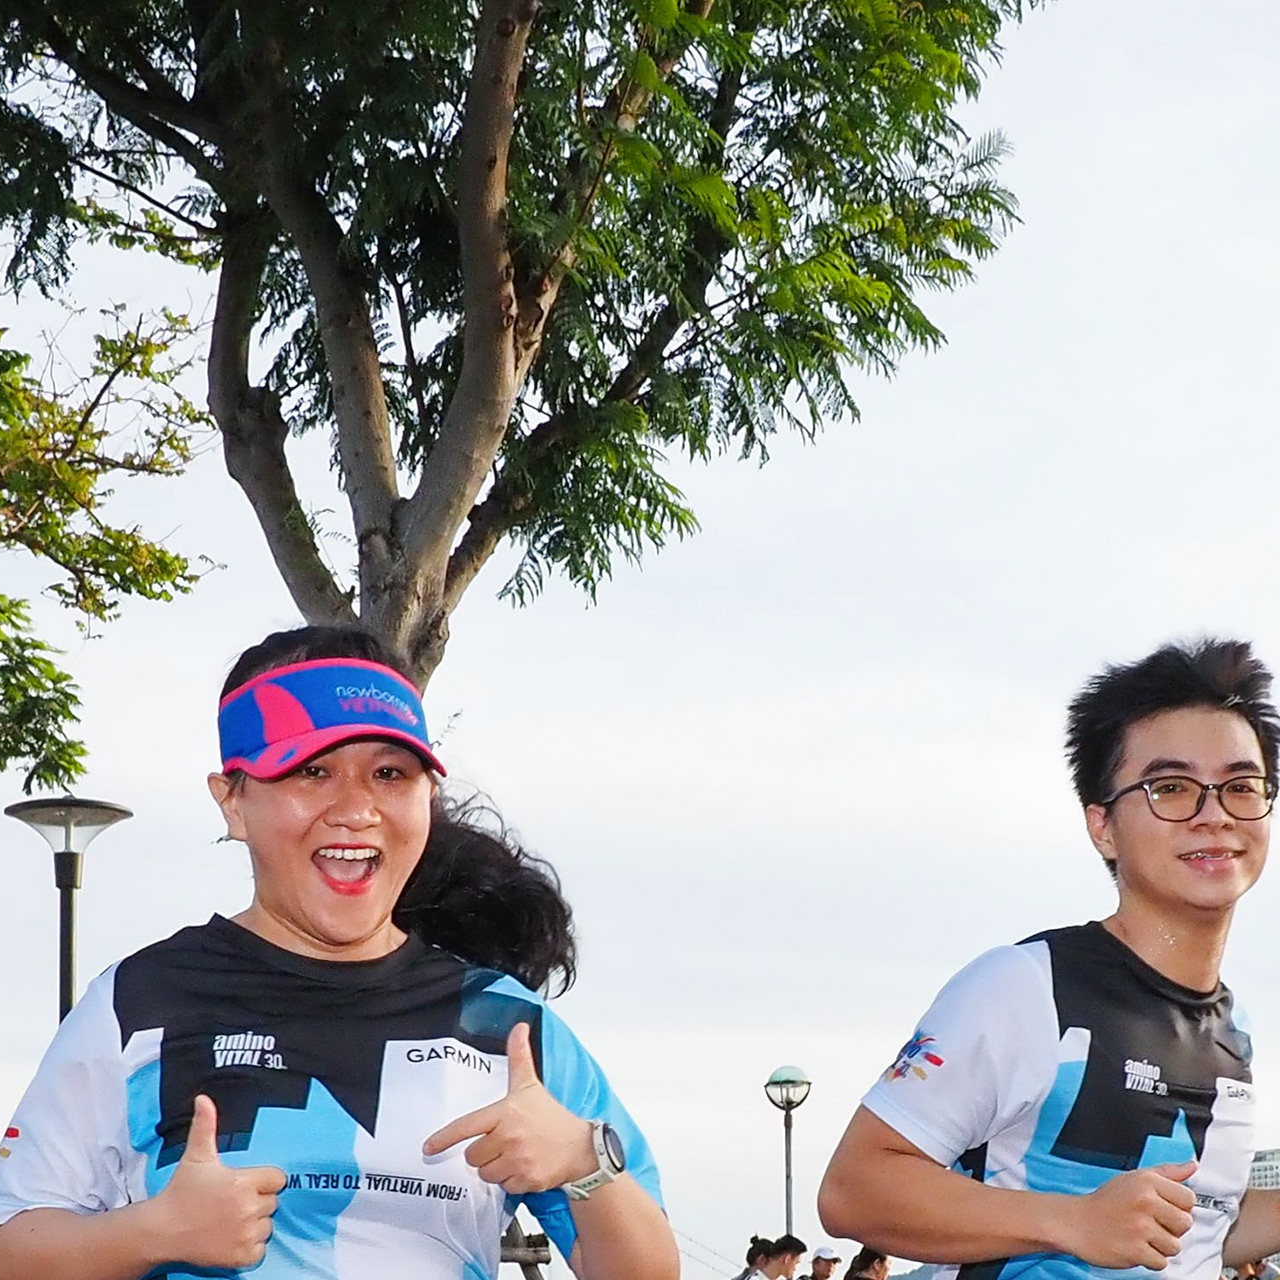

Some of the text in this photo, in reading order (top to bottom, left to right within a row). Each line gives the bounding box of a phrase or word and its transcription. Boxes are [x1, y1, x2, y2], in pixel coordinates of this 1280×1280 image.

[213, 1031, 275, 1051] amino
[214, 1050, 261, 1068] VITAL
[406, 1045, 492, 1074] GARMIN
[1124, 1059, 1161, 1080] amino
[1125, 1073, 1155, 1093] VITAL
[306, 1174, 340, 1190] REAL
[344, 1175, 361, 1190] TO
[365, 1175, 424, 1196] VIRTUAL
